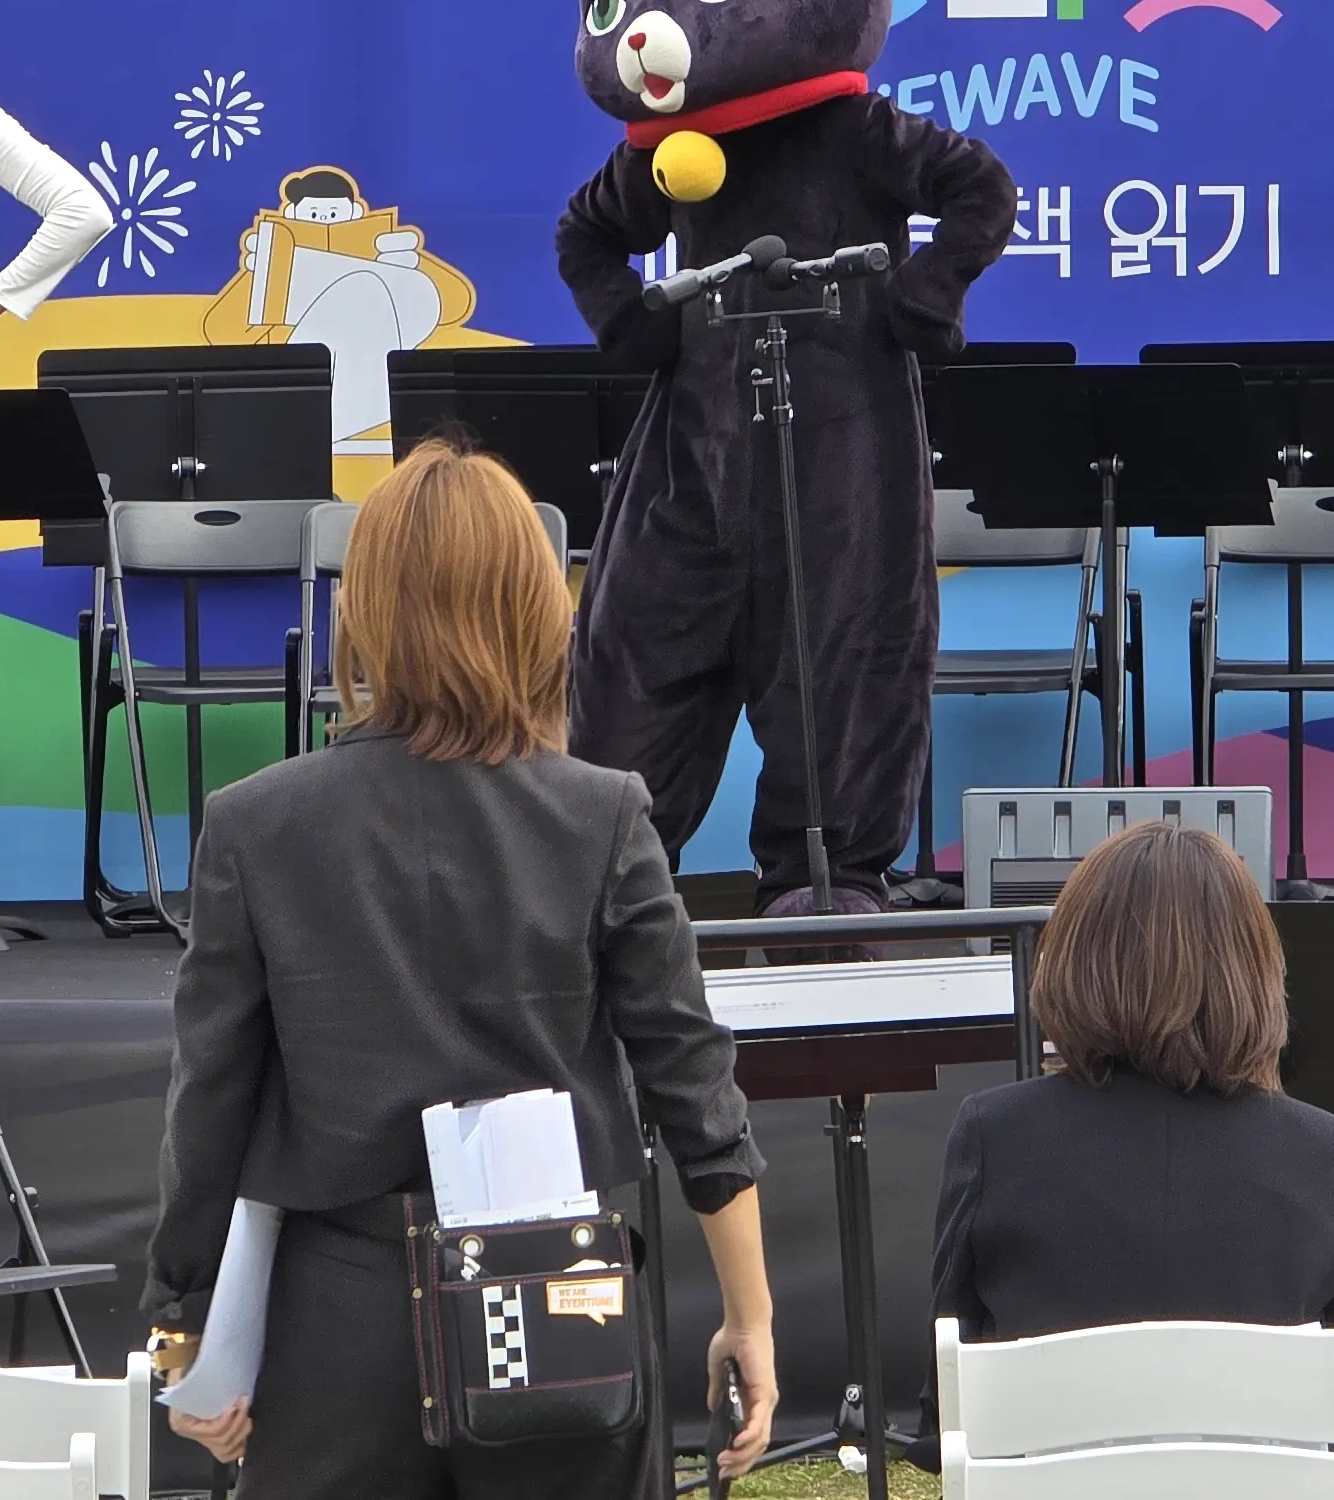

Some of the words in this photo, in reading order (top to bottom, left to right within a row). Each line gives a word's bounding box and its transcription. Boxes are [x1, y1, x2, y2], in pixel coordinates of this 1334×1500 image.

[877, 51, 1160, 133] EWAVE
[1002, 185, 1071, 278] 책
[1103, 179, 1280, 278] 읽기
